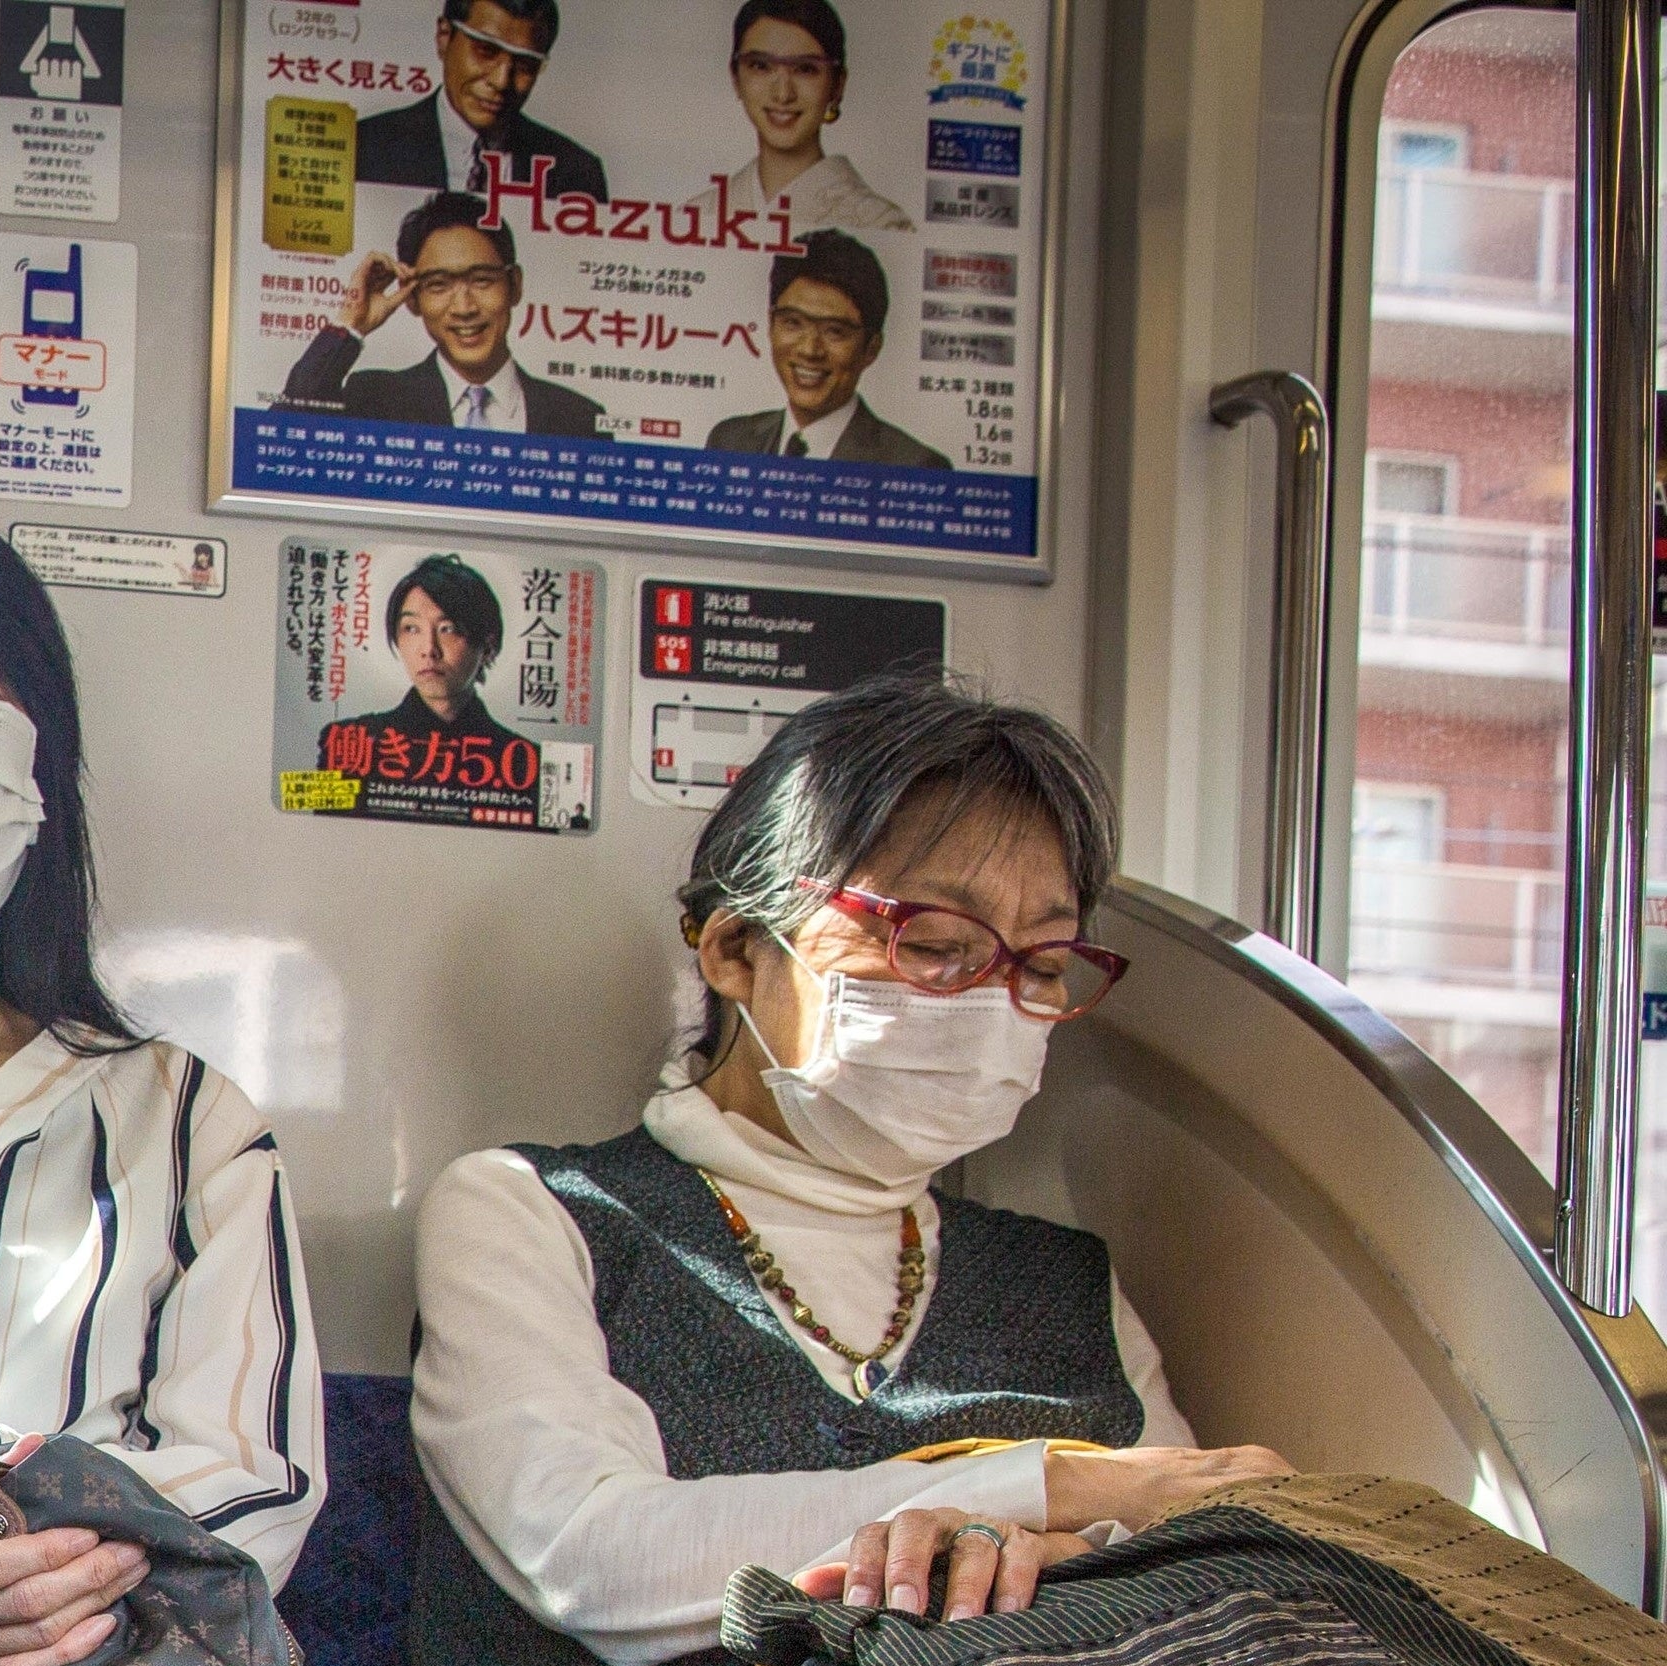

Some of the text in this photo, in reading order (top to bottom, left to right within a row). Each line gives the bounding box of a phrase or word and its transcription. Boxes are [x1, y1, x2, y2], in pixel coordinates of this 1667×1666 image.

[947, 41, 1011, 63] ギフトに
[268, 52, 433, 94] 大きく見える
[478, 152, 807, 257] Hazuki
[519, 302, 761, 358] ハズキルーペ
[13, 343, 91, 364] マナー
[34, 368, 68, 381] モード
[0, 423, 95, 442] マナーモードに
[257, 443, 296, 458] ヨドバシ
[306, 449, 365, 464] ビックカメラ
[256, 463, 315, 478] ケーズデンキ
[704, 611, 814, 633] Fire extinguisher
[517, 567, 562, 724] 落合陽一
[657, 636, 686, 649] SOS
[703, 659, 806, 680] Emergency call
[325, 724, 538, 790] 働き方5.0
